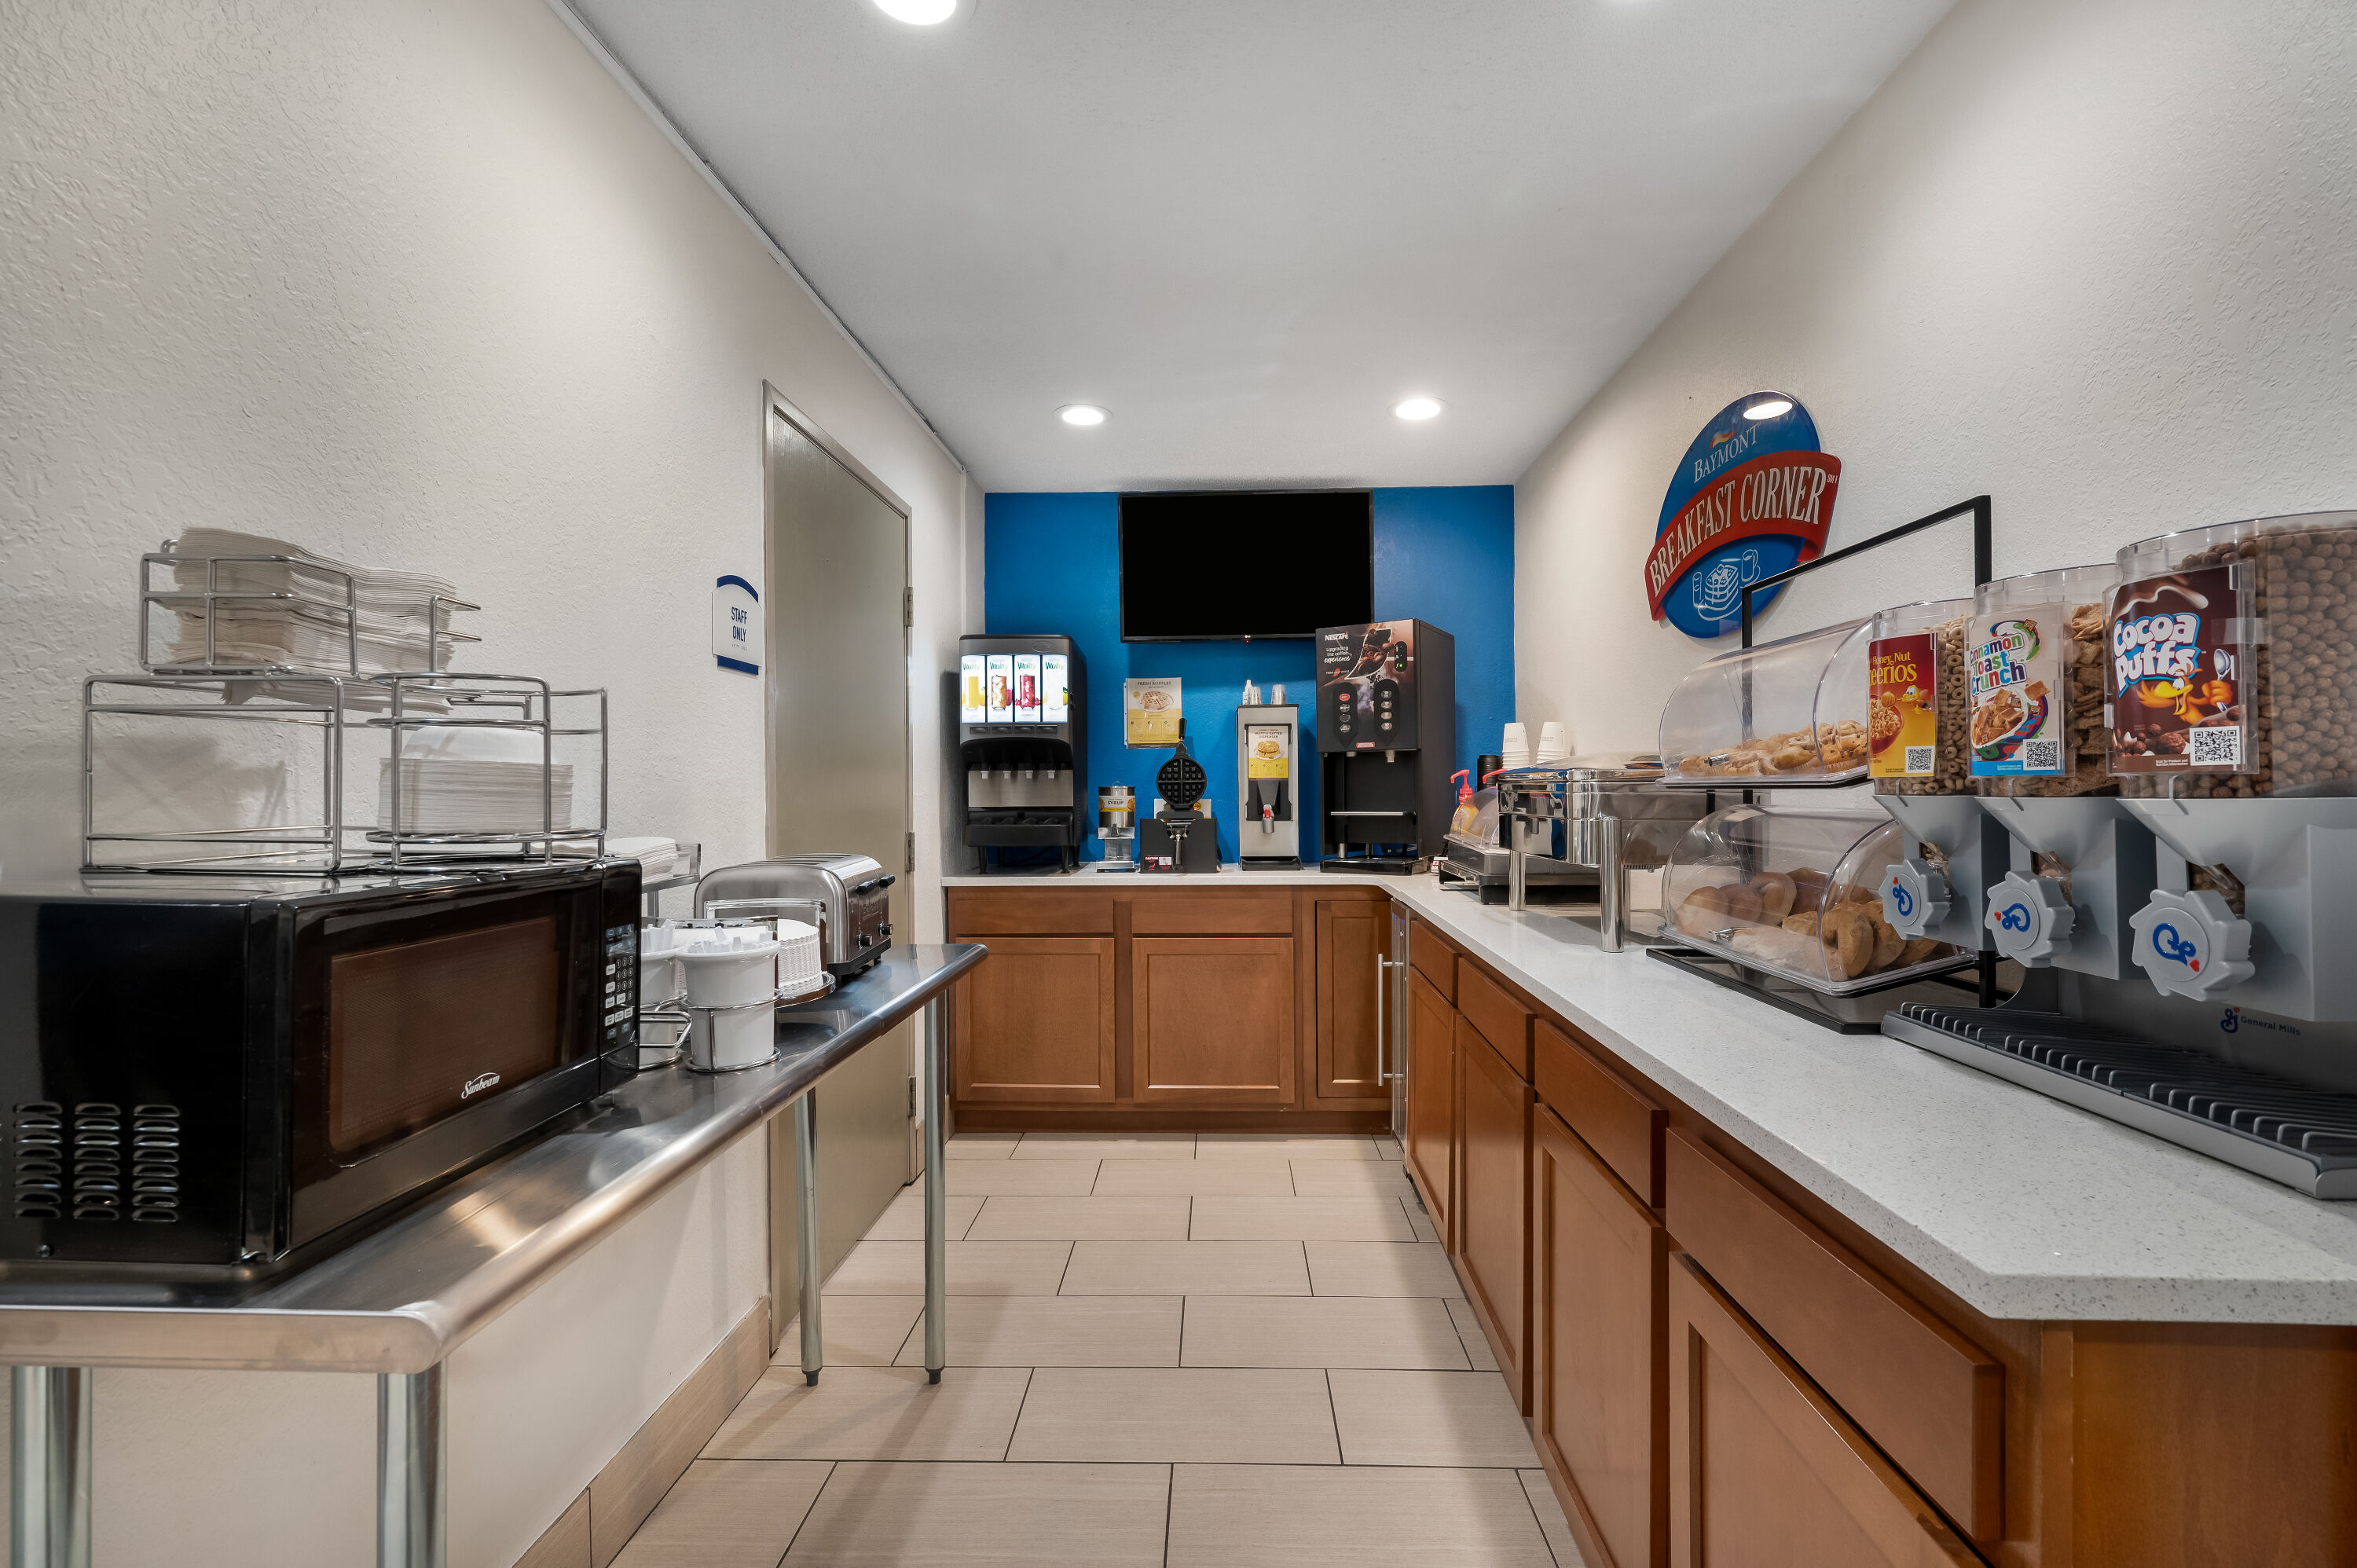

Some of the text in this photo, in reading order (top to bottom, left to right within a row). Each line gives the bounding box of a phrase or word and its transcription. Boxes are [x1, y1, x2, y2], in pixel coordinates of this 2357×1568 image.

[1694, 424, 1758, 483] BAYMONT
[1649, 466, 1827, 598] BREAKFAST CORNER
[731, 606, 748, 625] STAFF
[732, 625, 746, 642] ONLY
[1872, 651, 1912, 665] Honey Nut
[1971, 635, 2023, 663] innamon
[1974, 651, 2009, 677] Toast
[2240, 1016, 2301, 1036] General Mills
[460, 1073, 500, 1099] Sunbeam
